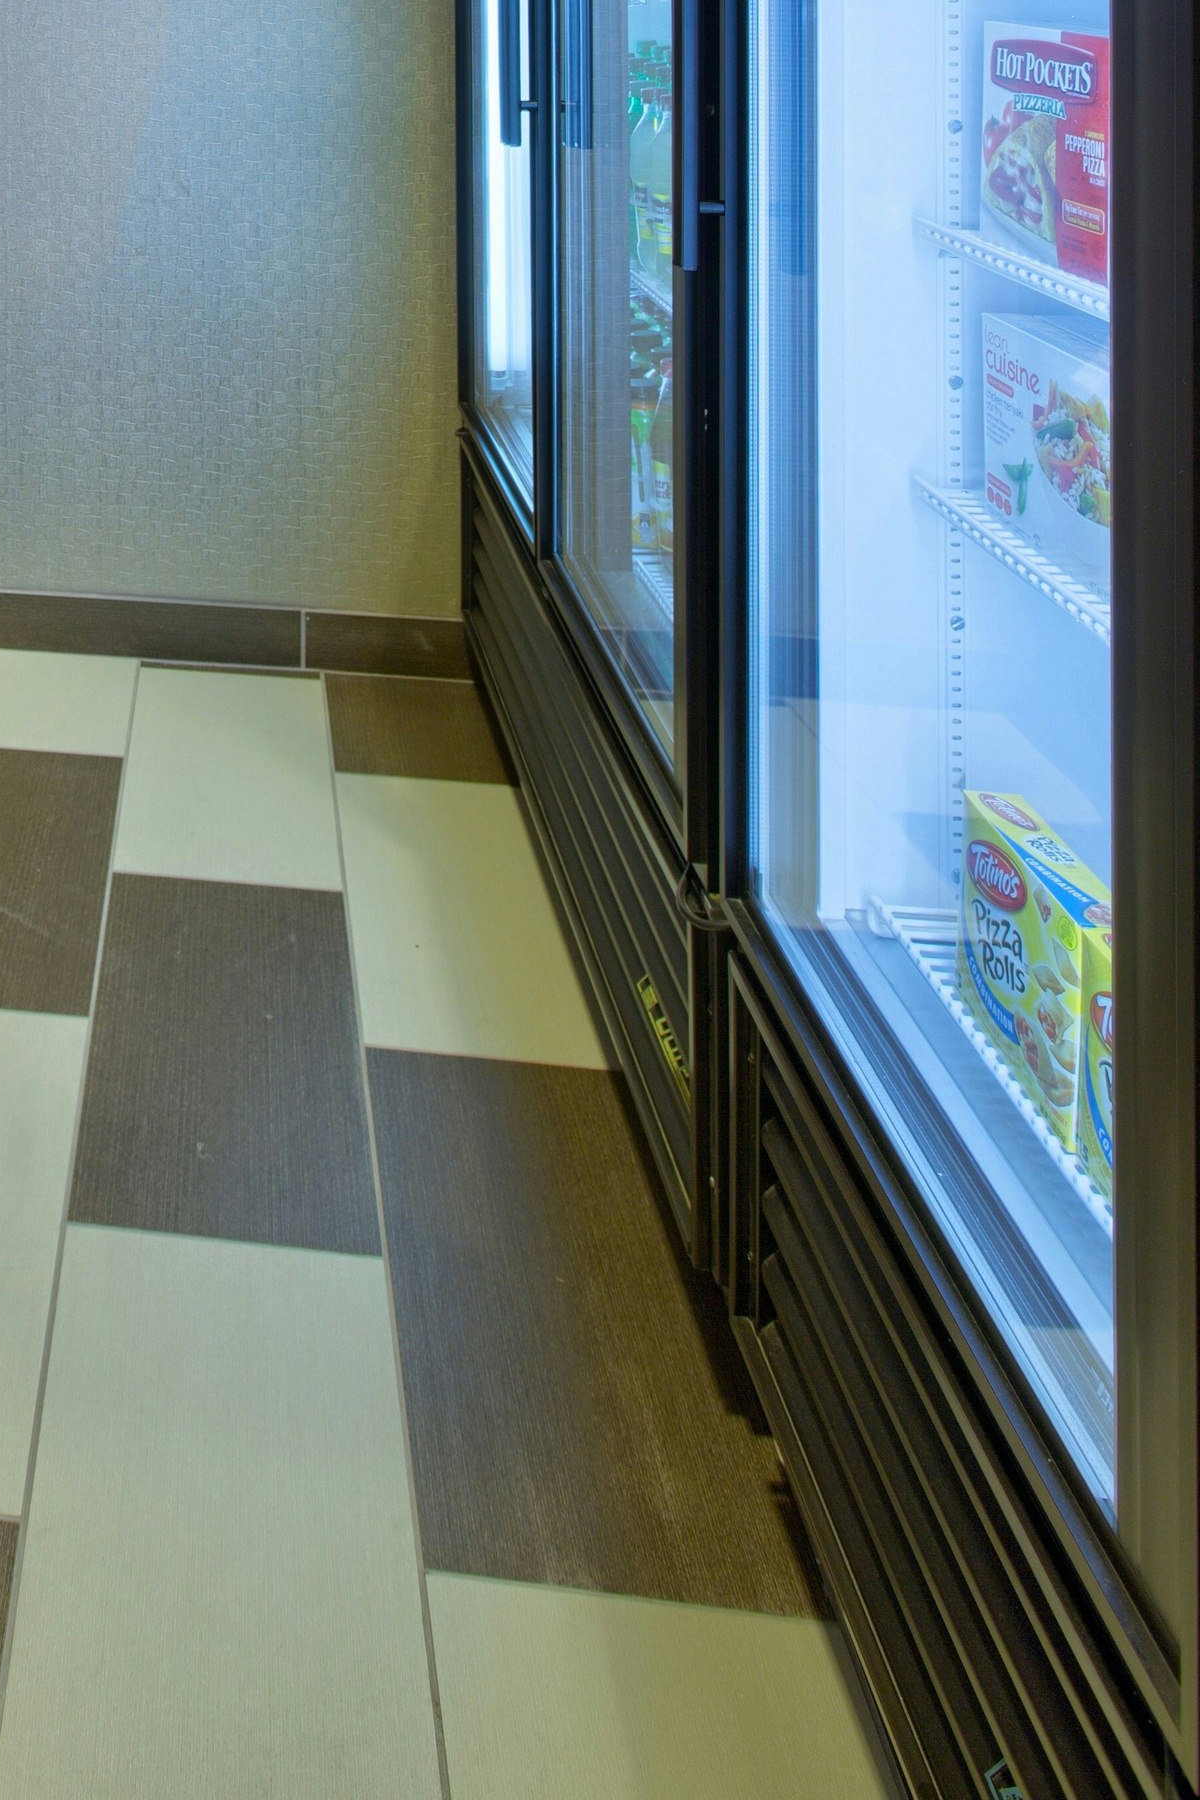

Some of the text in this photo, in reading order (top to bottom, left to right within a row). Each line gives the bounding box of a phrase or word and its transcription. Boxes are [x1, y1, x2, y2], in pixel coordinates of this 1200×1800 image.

[995, 47, 1094, 94] HOT POCKETS
[1012, 94, 1067, 119] PIZZERIA
[1064, 133, 1105, 160] PEPPERONI
[1082, 155, 1105, 177] PIZZA
[985, 348, 1040, 395] cuisine
[971, 842, 1020, 899] Totino's
[1024, 857, 1090, 903] COMBINATION
[971, 898, 1022, 962] Pizza
[978, 938, 1026, 994] Rolls
[968, 955, 1014, 1034] COMBINATION
